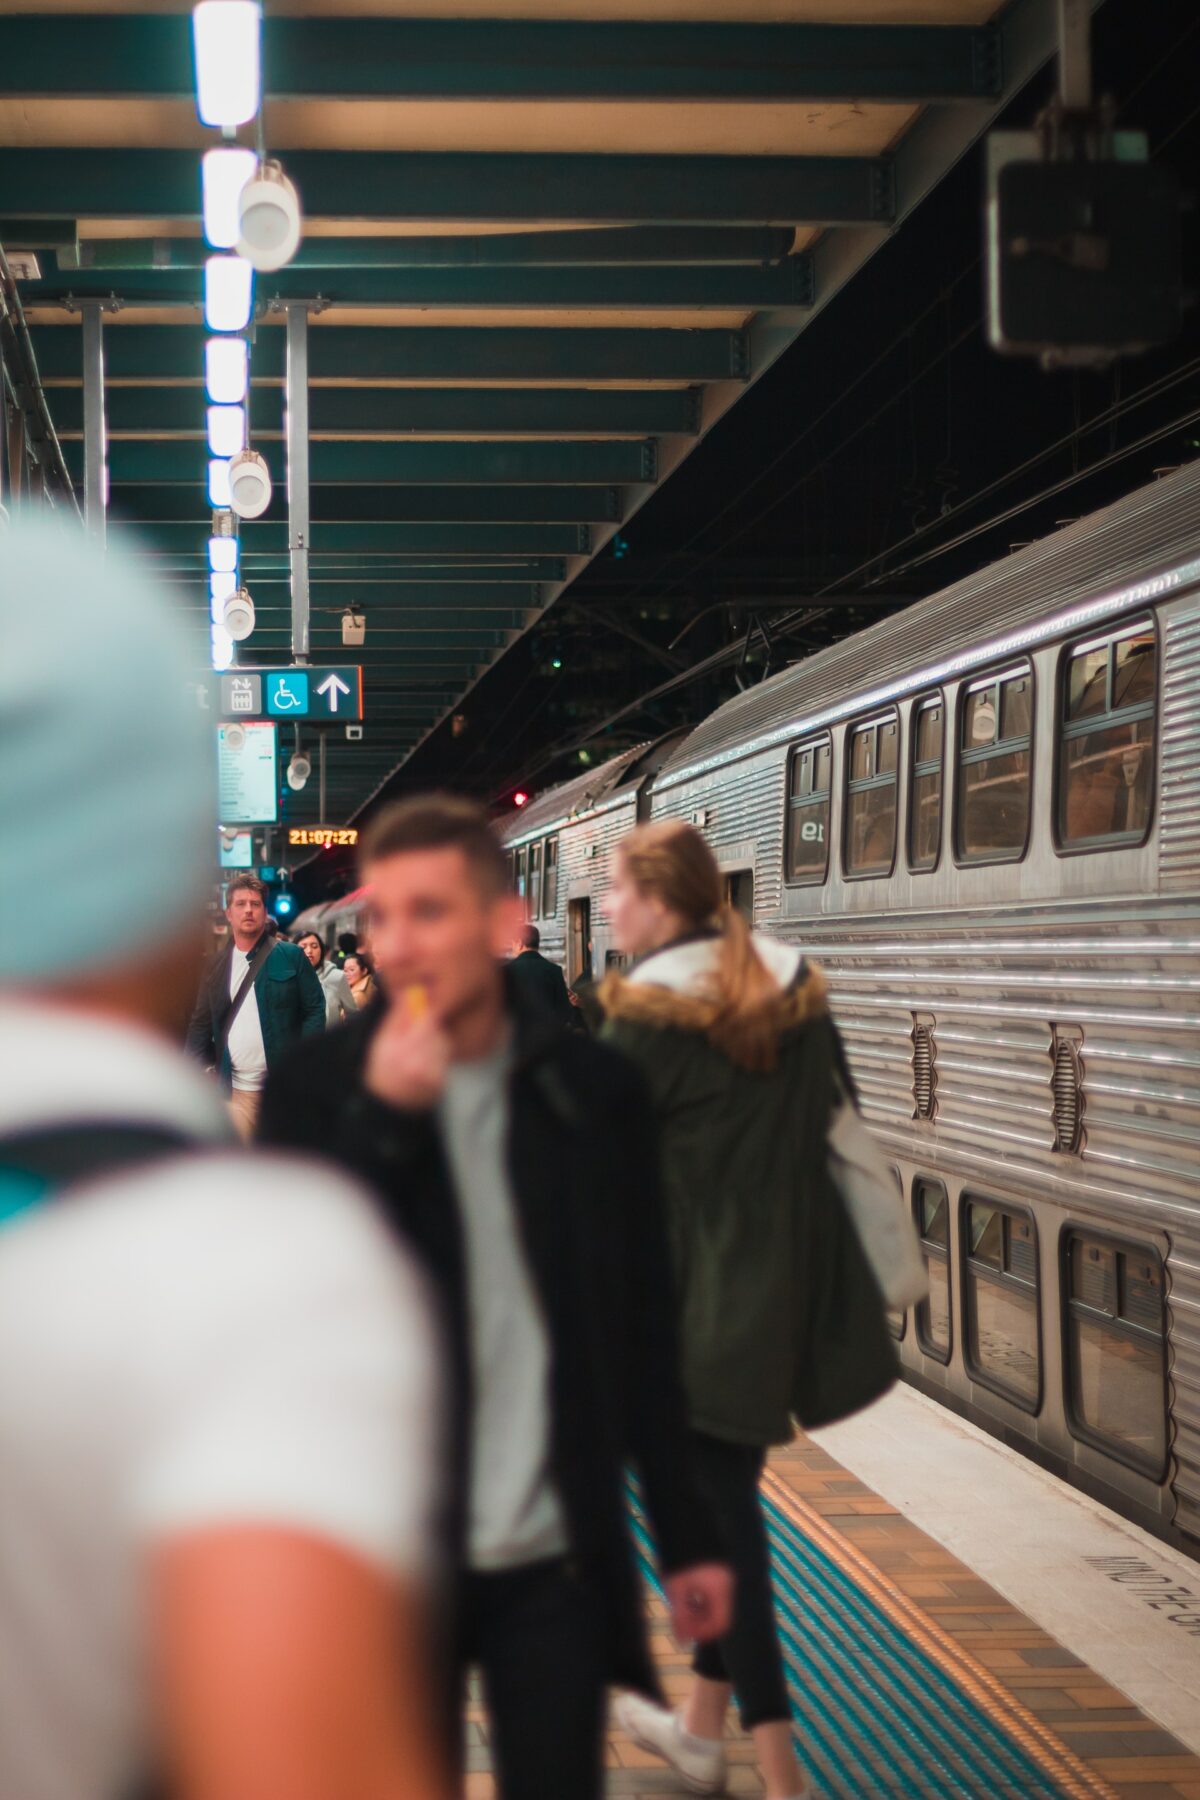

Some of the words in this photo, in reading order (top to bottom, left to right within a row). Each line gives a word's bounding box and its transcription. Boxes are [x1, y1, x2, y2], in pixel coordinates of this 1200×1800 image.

[289, 829, 358, 845] 21:07:27
[1080, 1555, 1173, 1584] MIND
[1126, 1586, 1200, 1610] THE
